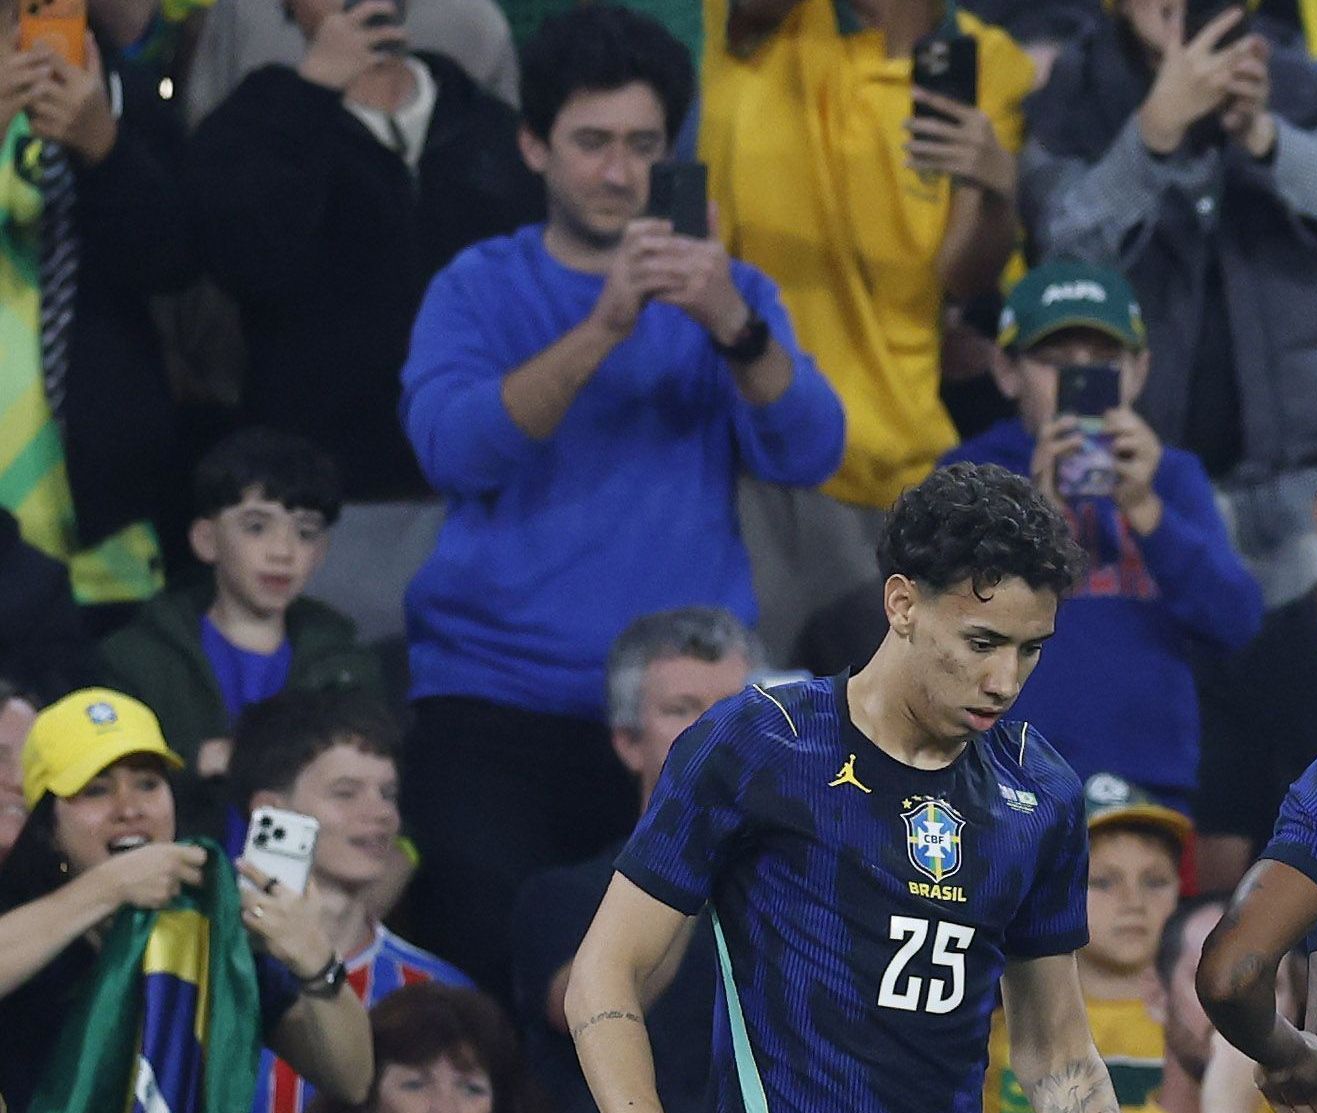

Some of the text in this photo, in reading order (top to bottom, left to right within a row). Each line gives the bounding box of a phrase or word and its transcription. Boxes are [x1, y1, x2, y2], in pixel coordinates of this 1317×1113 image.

[924, 834, 944, 844] CBF
[908, 881, 967, 902] BRASIL
[877, 915, 976, 1014] 25
